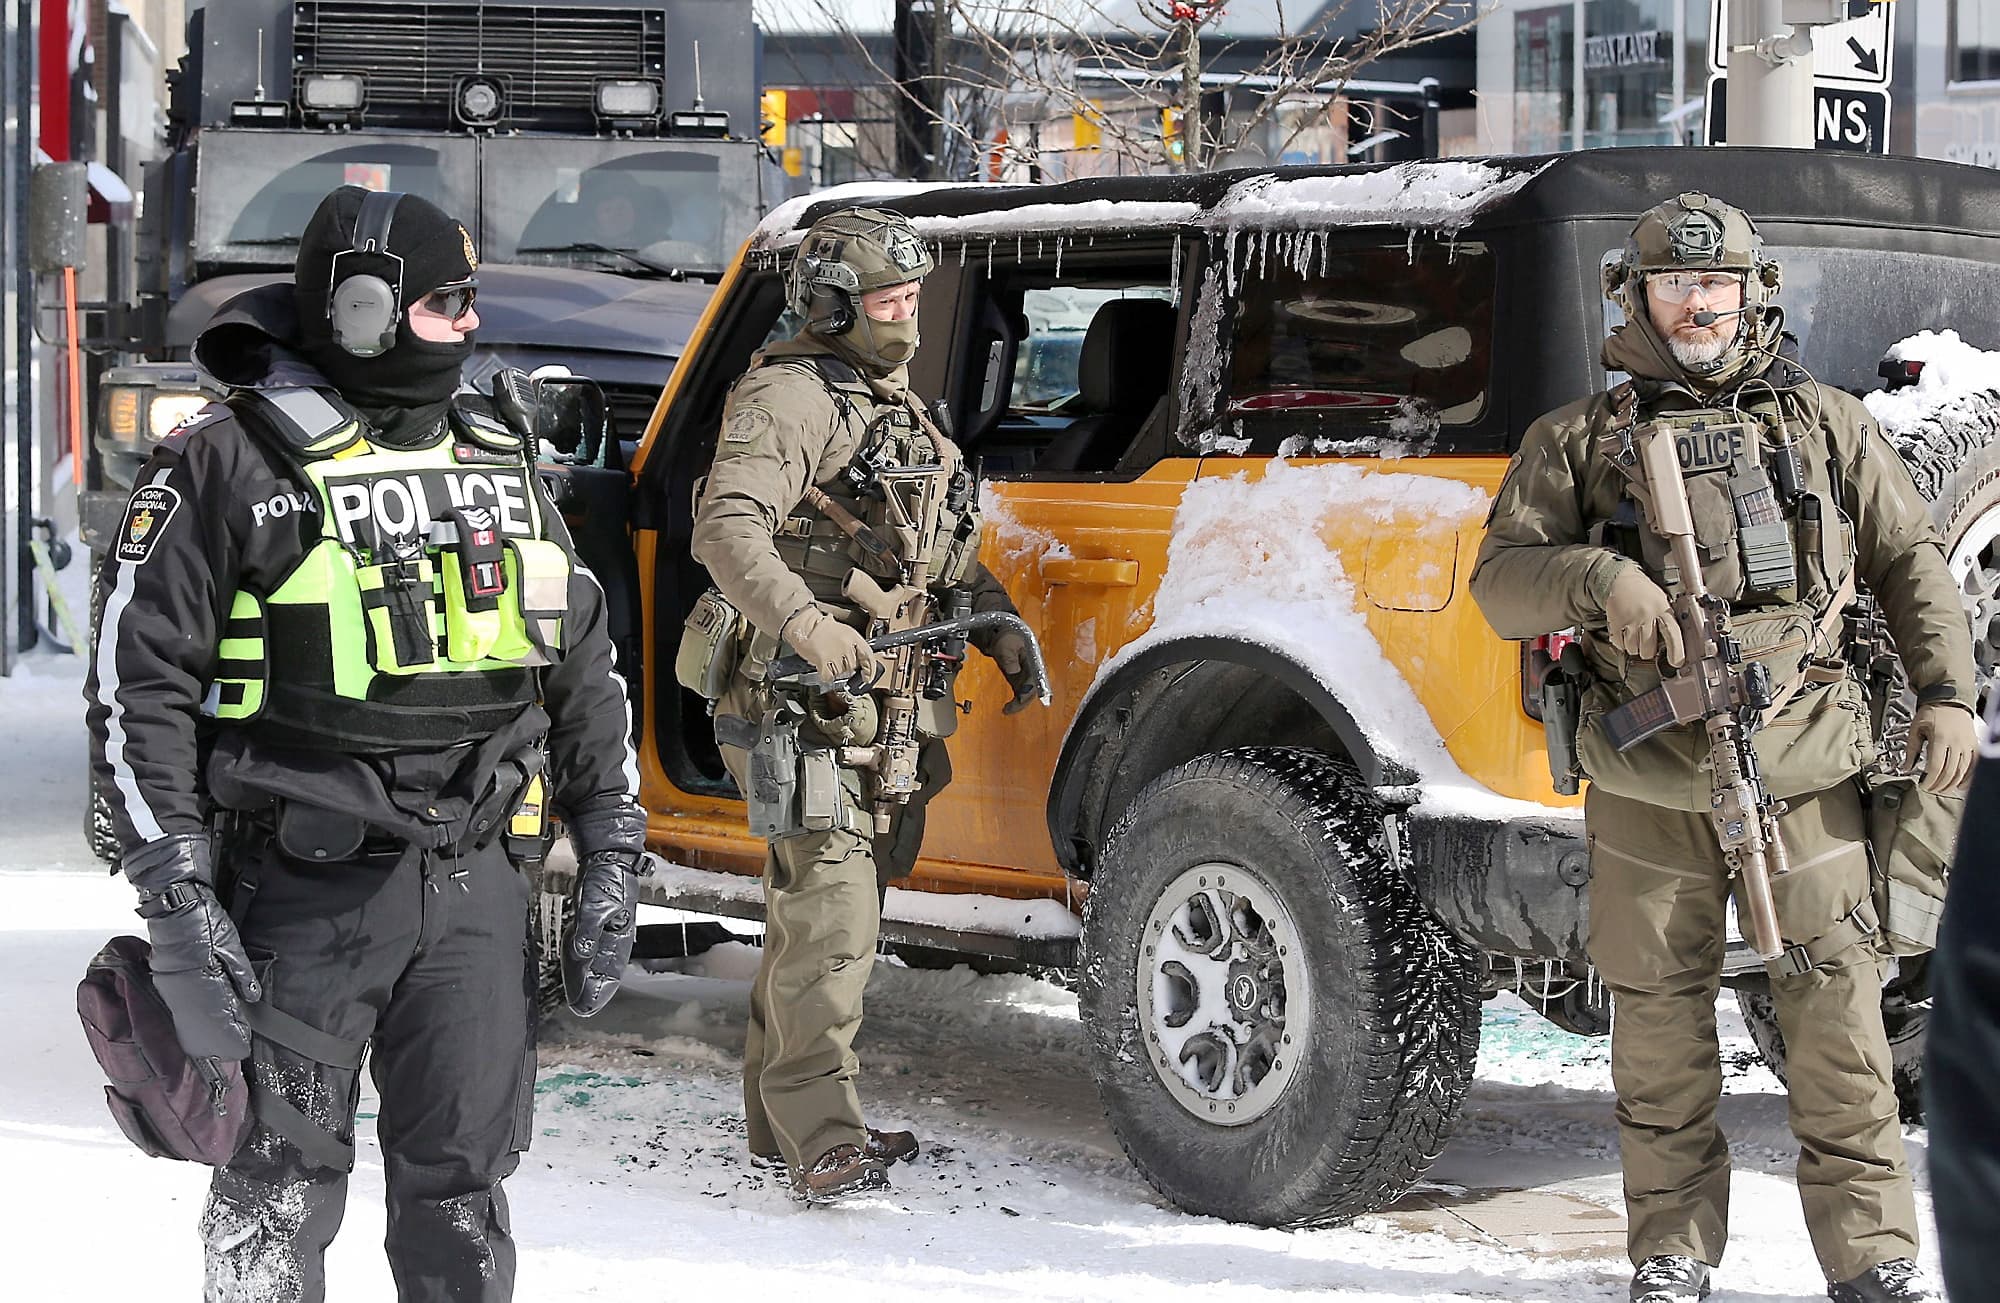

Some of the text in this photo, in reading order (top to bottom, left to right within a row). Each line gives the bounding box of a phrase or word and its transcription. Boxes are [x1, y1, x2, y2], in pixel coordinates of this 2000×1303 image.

[1675, 430, 1745, 469] OLICE
[132, 500, 167, 511] REGIONAL
[141, 491, 165, 500] YORK
[330, 473, 531, 543] POLICE
[251, 490, 317, 528] POLI
[121, 543, 147, 555] POLICE
